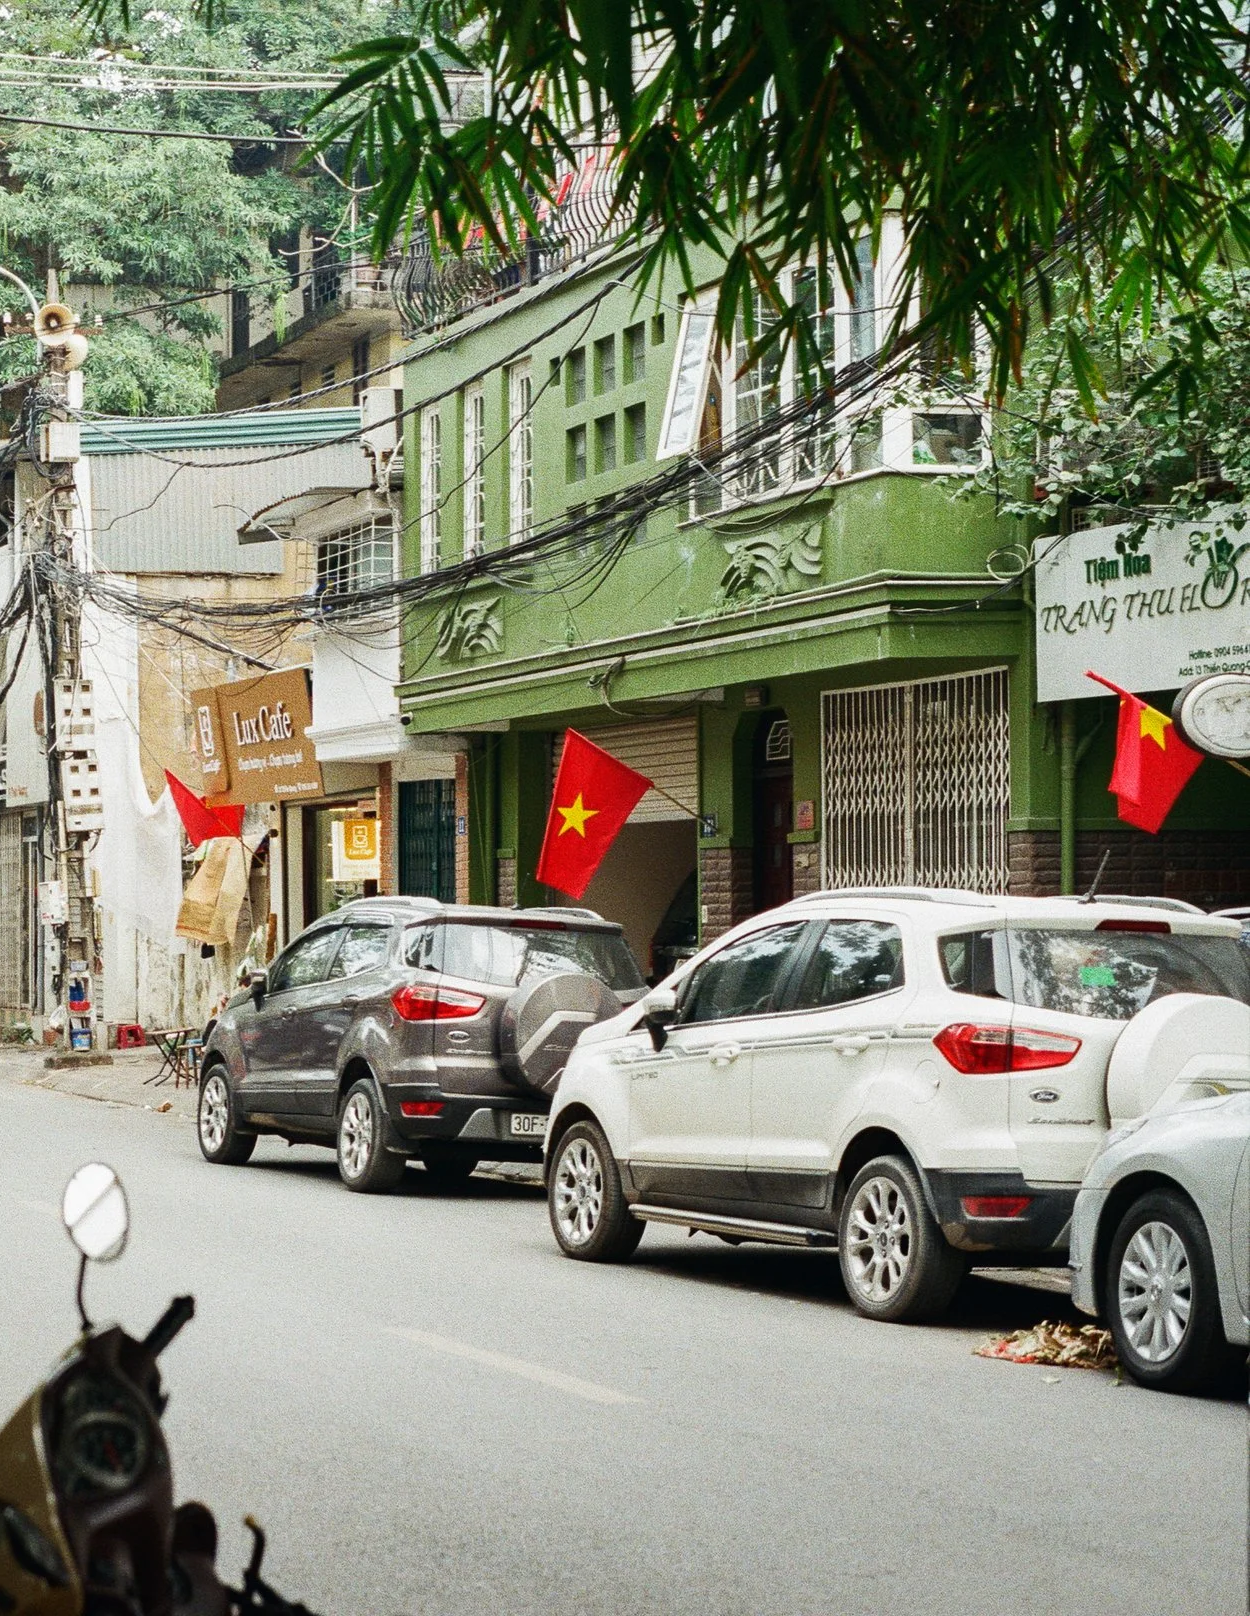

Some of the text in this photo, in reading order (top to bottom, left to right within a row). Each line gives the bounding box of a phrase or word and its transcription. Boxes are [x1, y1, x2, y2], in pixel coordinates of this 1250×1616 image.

[1084, 552, 1151, 589] Tiệm Hoa
[1041, 596, 1117, 635] TRANG
[1124, 586, 1174, 621] THU
[233, 711, 260, 746] Lux
